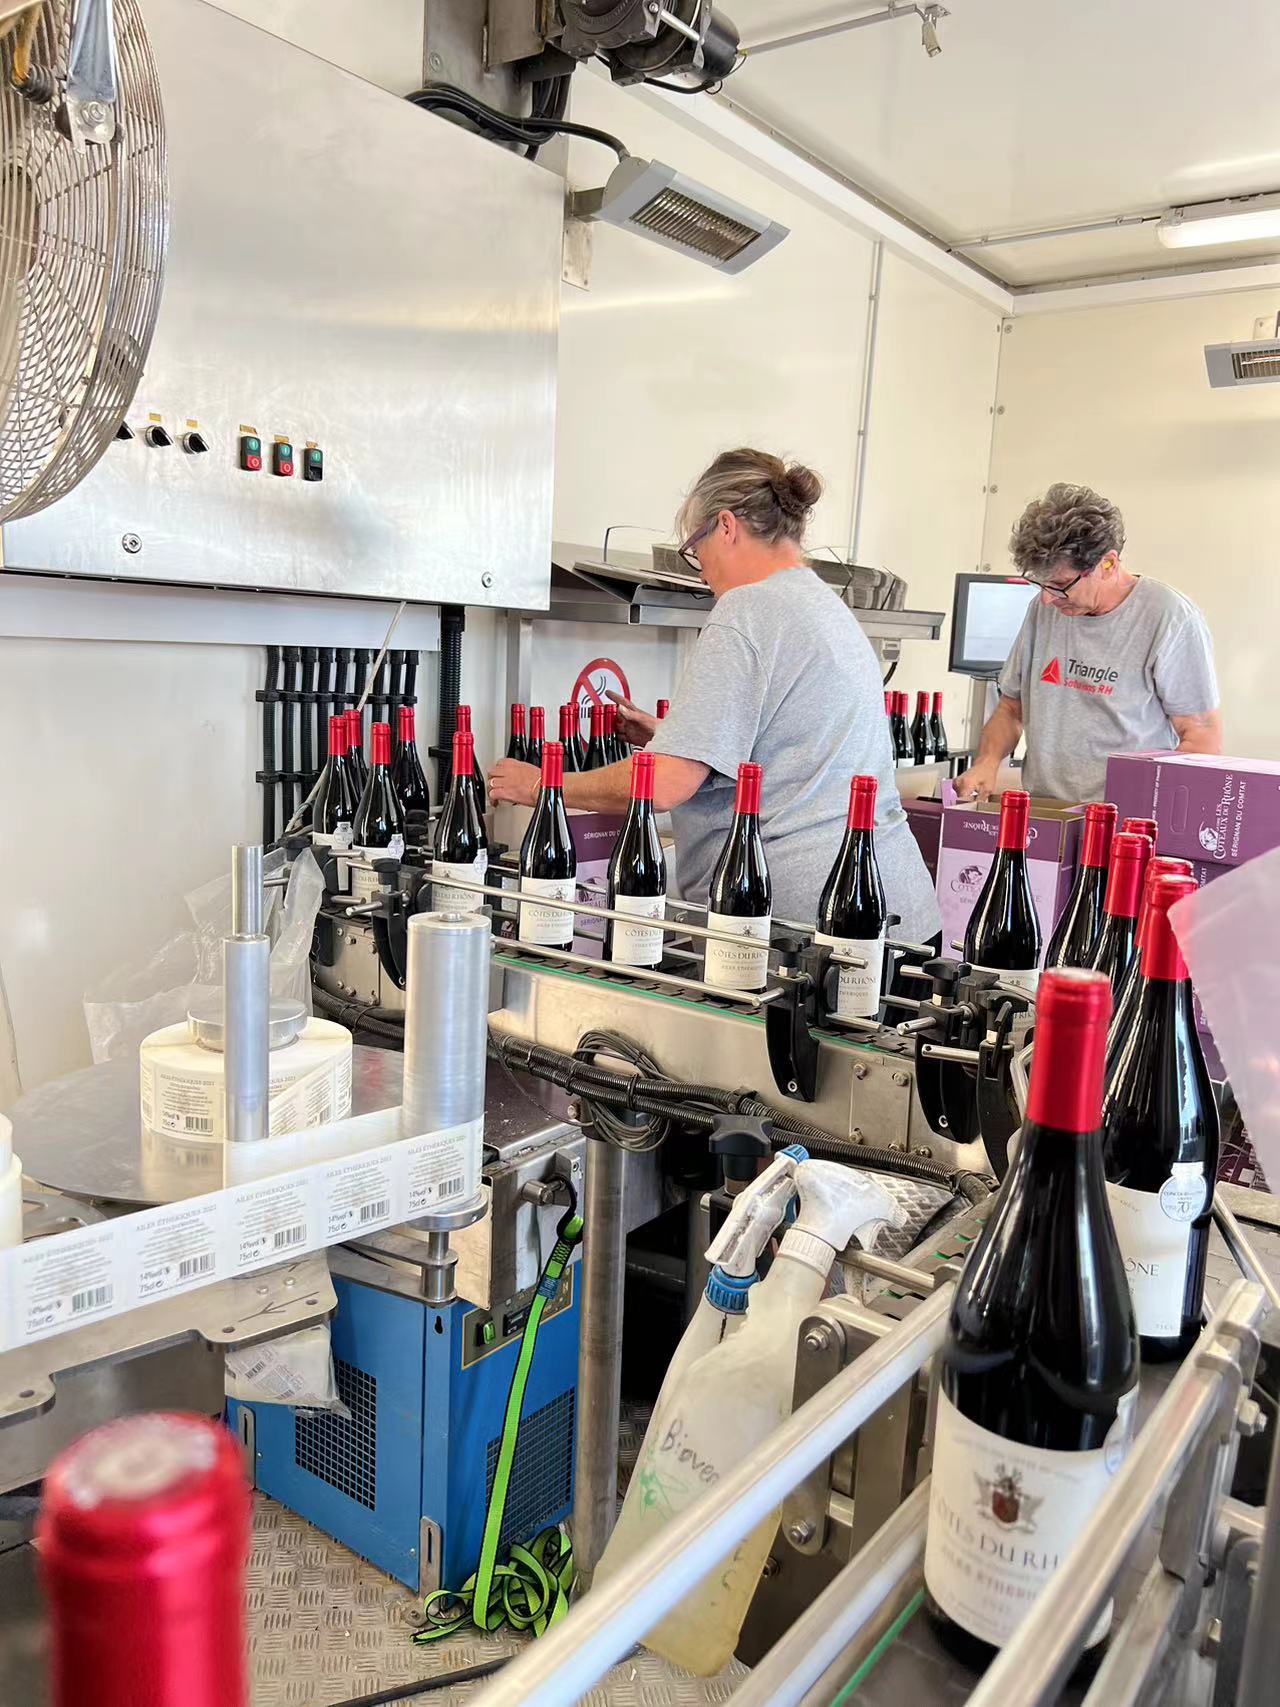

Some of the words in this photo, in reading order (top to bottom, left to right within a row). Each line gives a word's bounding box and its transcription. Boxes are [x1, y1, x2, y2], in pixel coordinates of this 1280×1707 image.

[1067, 658, 1119, 684] Triangle
[1097, 684, 1114, 695] RH
[1237, 781, 1247, 809] COMTAT
[1213, 817, 1228, 860] COTEAUX
[1221, 774, 1235, 806] RHÔNE
[1236, 810, 1243, 821] DU
[1231, 821, 1241, 857] SÉRIGNAN
[624, 928, 649, 937] CÔTES
[713, 949, 737, 960] CÔTES
[738, 952, 750, 960] DU
[980, 1535, 1017, 1563] DU
